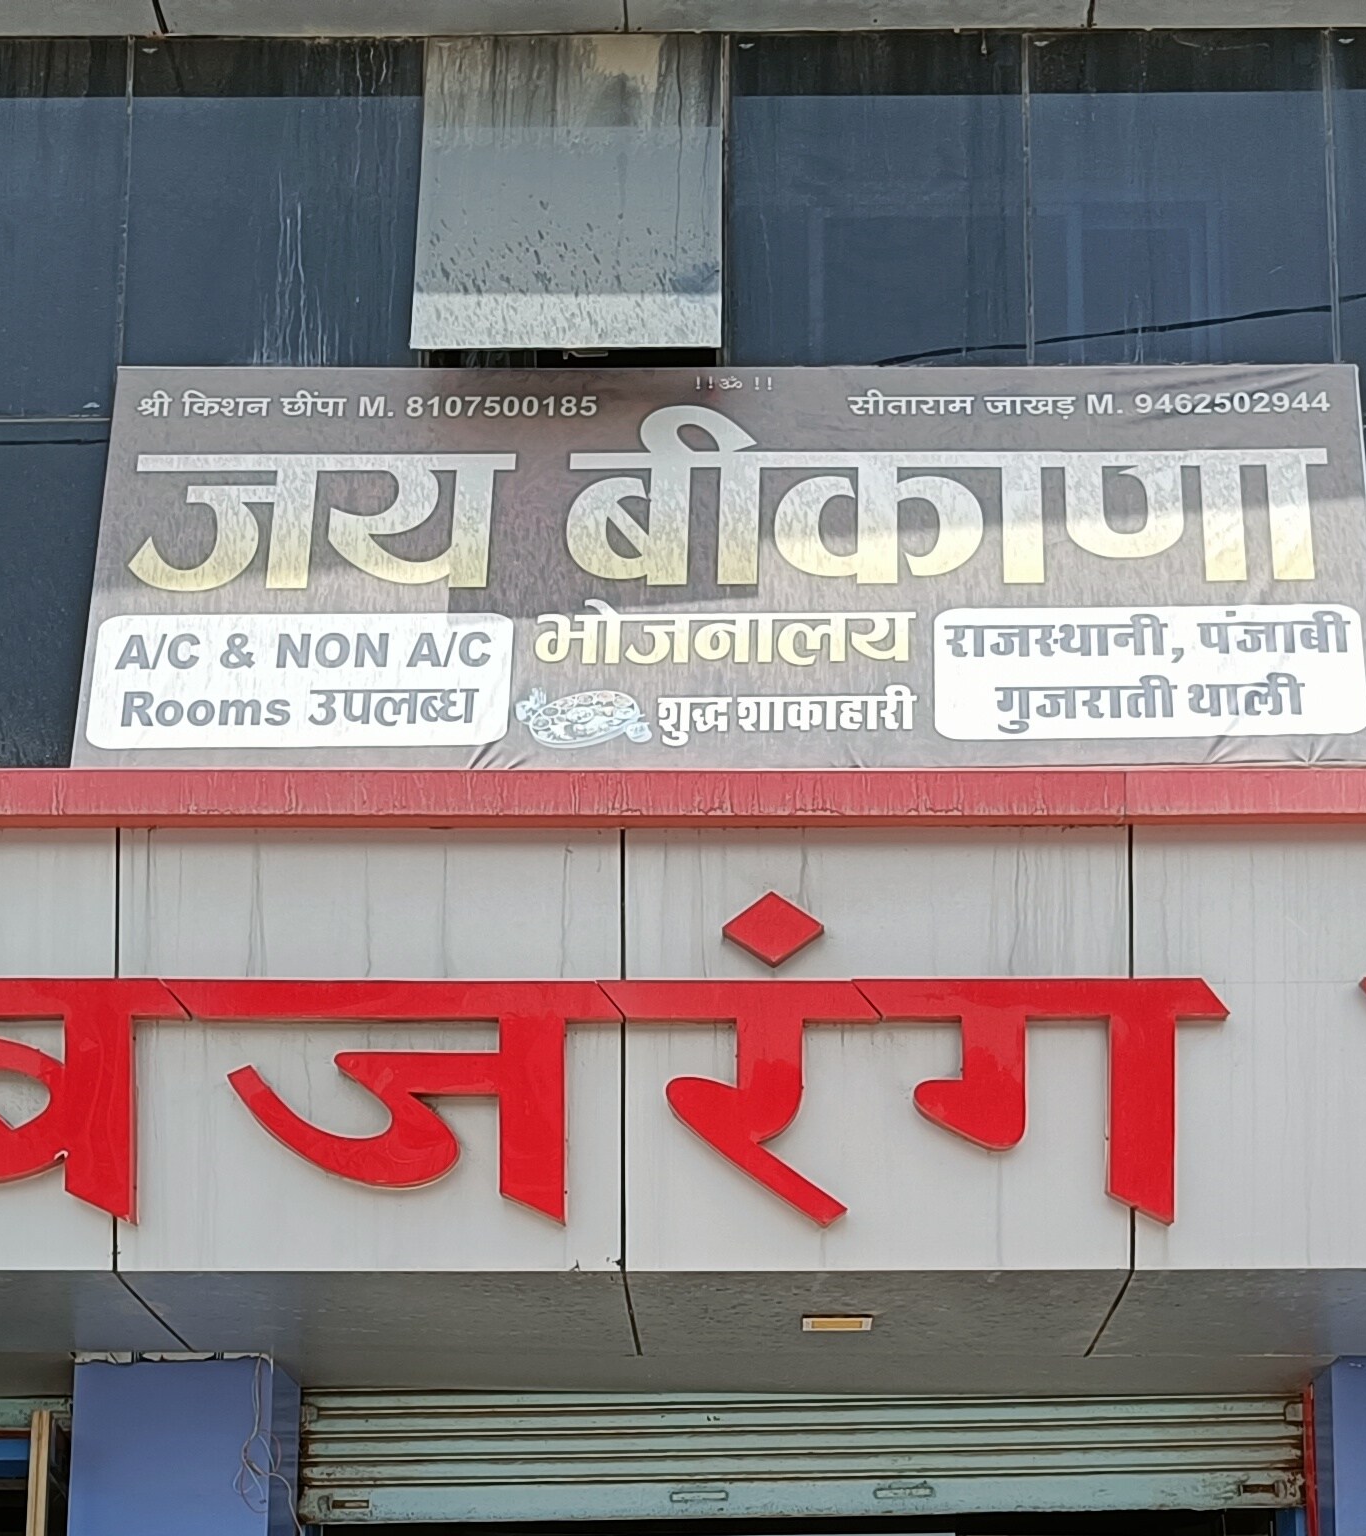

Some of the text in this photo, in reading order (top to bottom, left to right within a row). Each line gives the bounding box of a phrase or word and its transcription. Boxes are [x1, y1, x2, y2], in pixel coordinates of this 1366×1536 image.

[137, 389, 597, 417] श्री किशन छींपा M. 8107500185
[847, 391, 1331, 421] सीताराम जाखड़ M. 9462502944
[128, 405, 1327, 592] जय बीकाणा
[116, 630, 492, 670] A/C & NON A/C
[535, 599, 917, 666] भोजनालय
[944, 608, 1350, 664] राजस्थानी, पंजाबी
[120, 688, 480, 728] Rooms उपलब्ध
[657, 684, 918, 746] शुद्ध शाकाहारी
[995, 671, 1306, 734] गुजराती थाली
